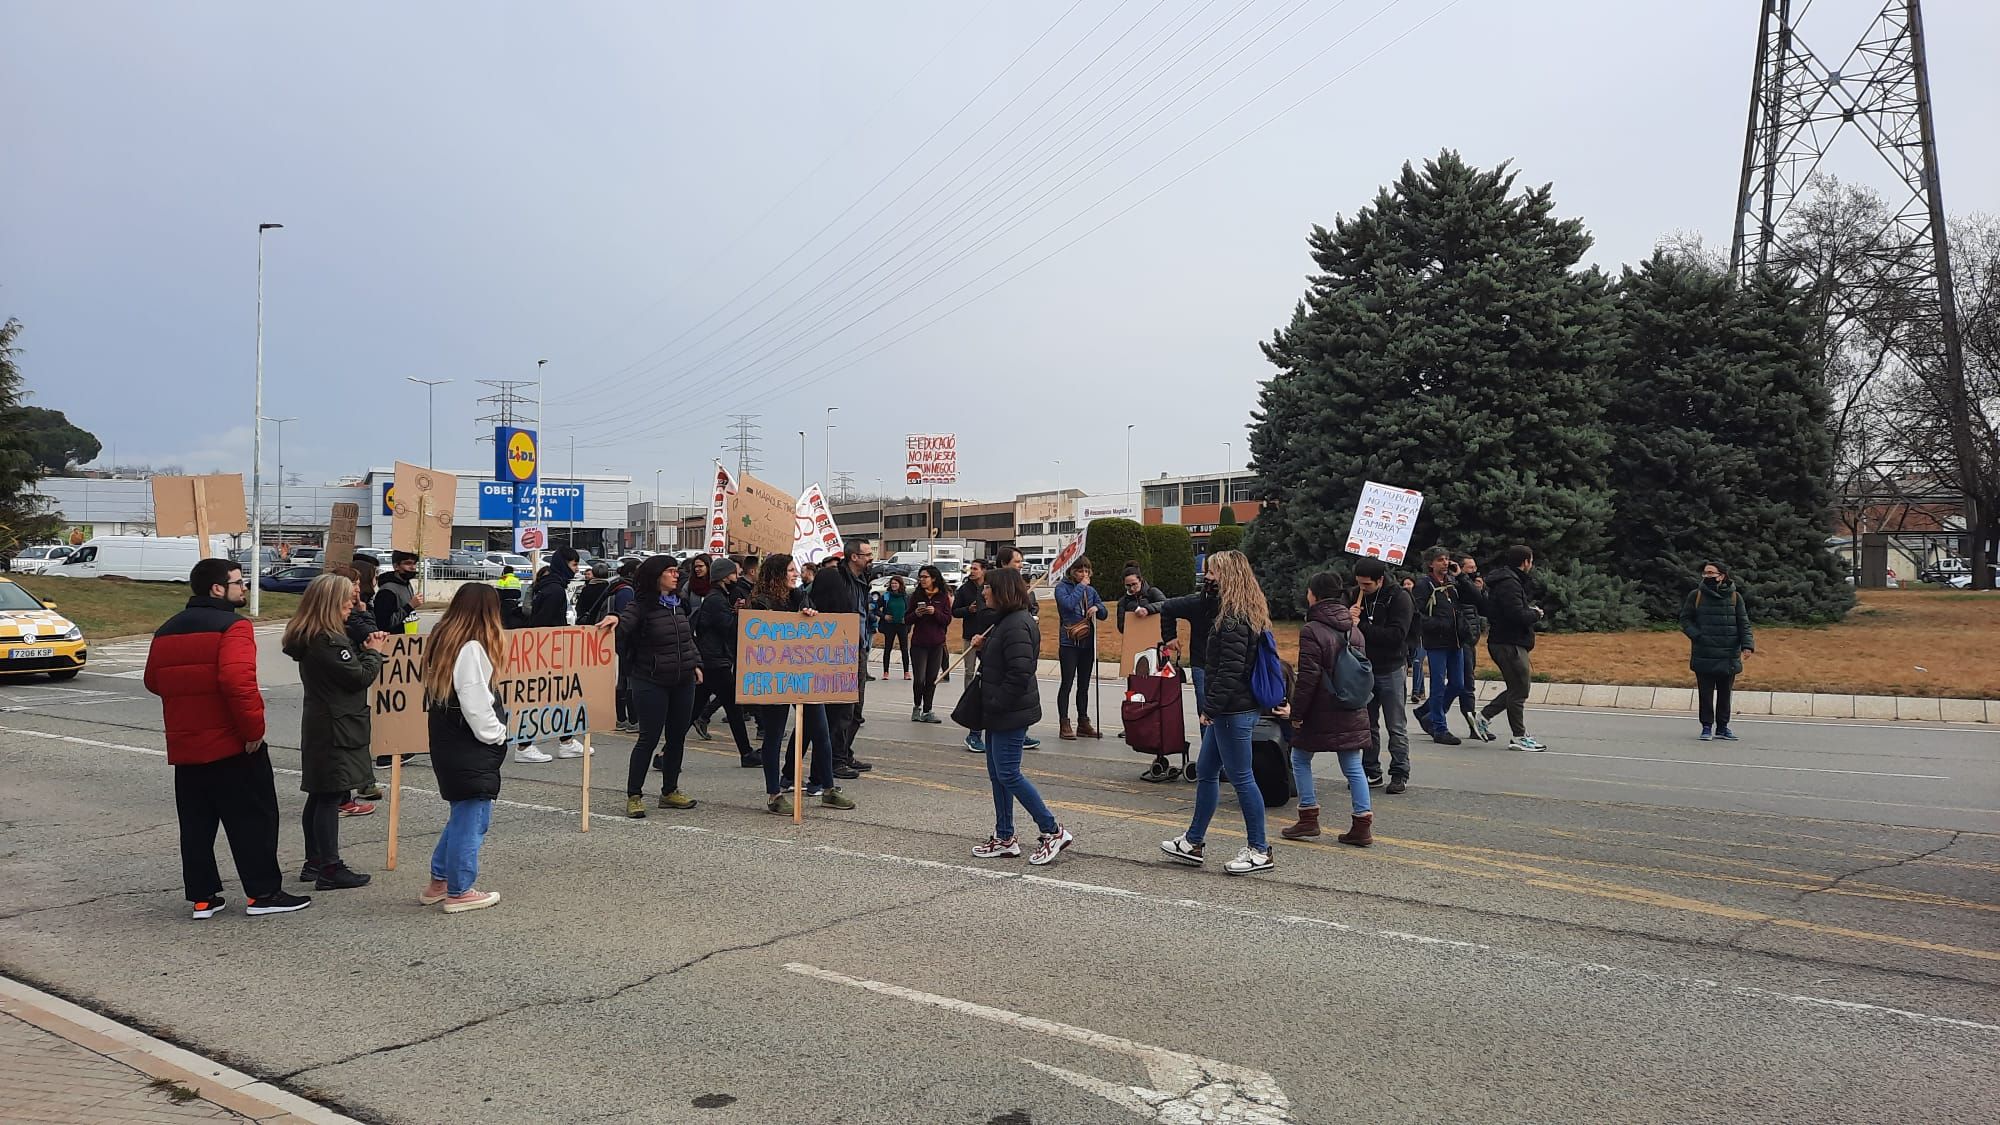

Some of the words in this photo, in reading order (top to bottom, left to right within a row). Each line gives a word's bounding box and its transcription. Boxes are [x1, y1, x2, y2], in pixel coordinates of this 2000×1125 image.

[909, 450, 922, 462] NO
[922, 450, 933, 461] HA
[921, 463, 930, 473] UN
[484, 486, 521, 495] OBER
[531, 487, 580, 497] ABIERTO
[1368, 497, 1380, 506] NO
[745, 618, 837, 641] CAMBRAY
[15, 650, 36, 658] 7206
[38, 649, 52, 657] KSP
[505, 626, 612, 674] ARKETING
[746, 645, 776, 666] NO
[379, 659, 422, 686] TAN
[743, 671, 773, 696] PER
[774, 671, 814, 694] TANT
[499, 671, 583, 705] TREPITJA
[376, 689, 406, 715] NO
[504, 705, 587, 742] L'ESCOLA
